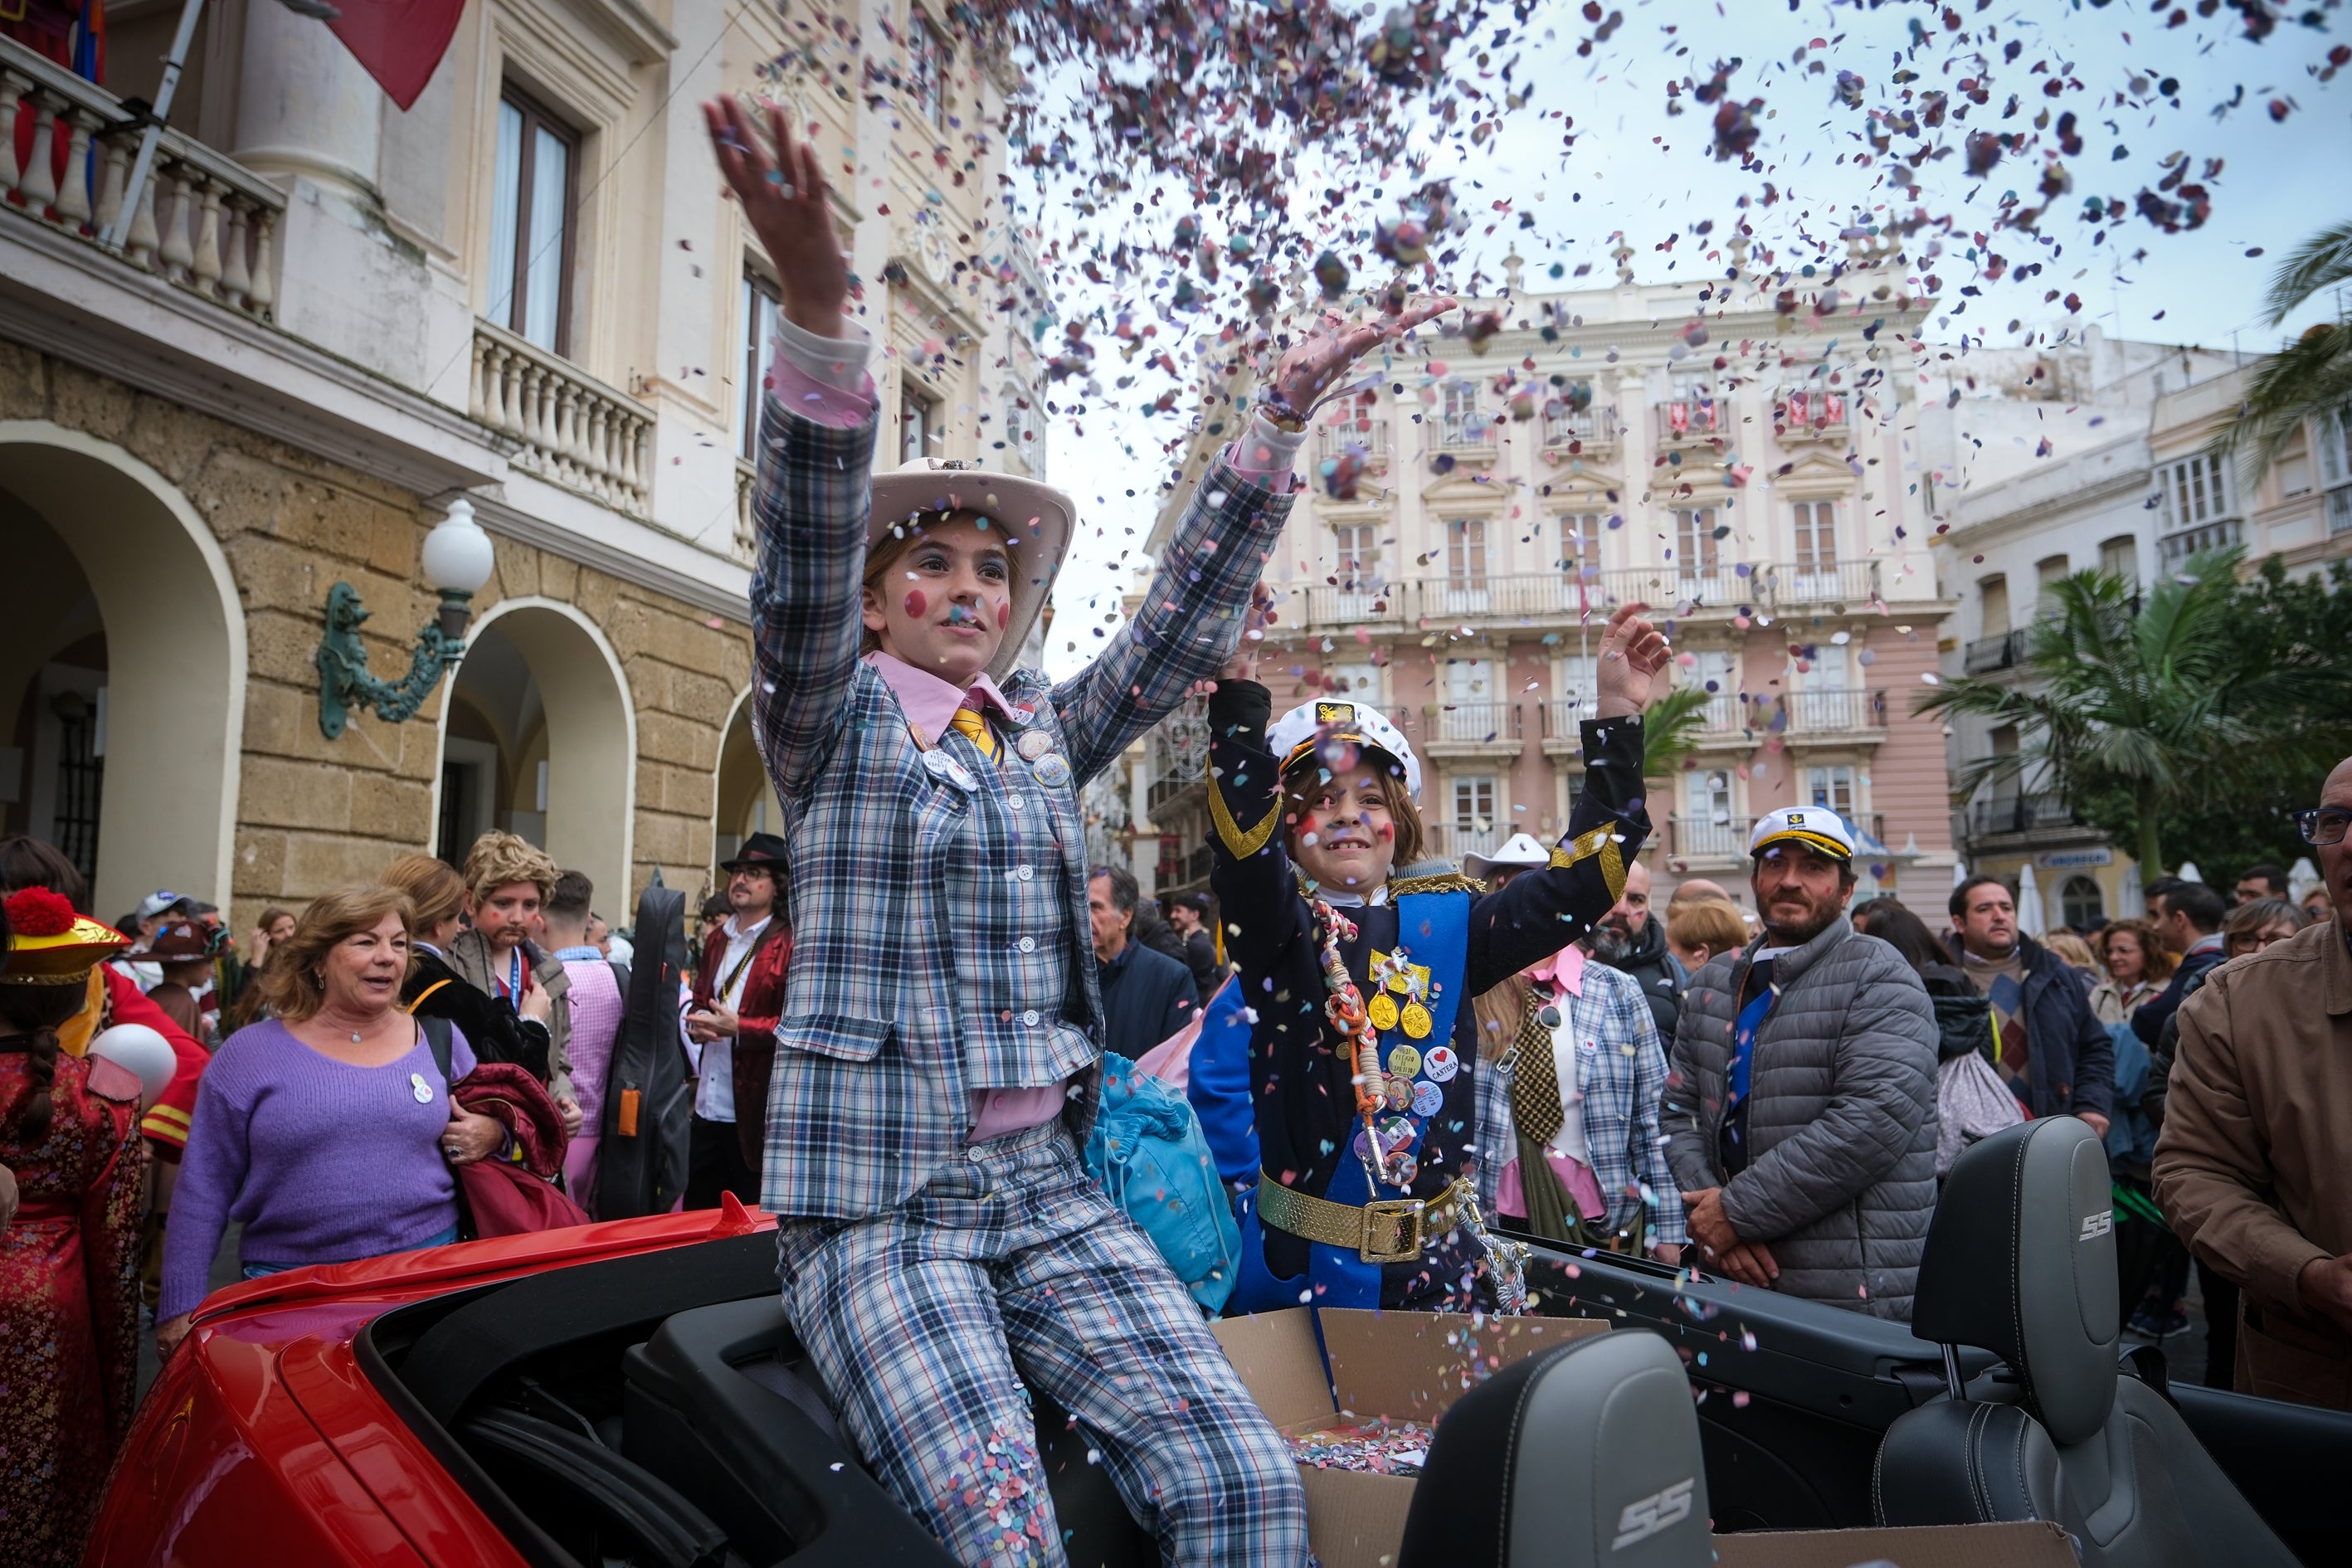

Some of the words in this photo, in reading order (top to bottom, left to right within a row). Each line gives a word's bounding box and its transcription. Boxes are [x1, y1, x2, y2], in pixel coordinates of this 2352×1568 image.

[1427, 1057, 1437, 1069] I
[1432, 1061, 1458, 1080] CANTERA
[2079, 1210, 2112, 1242] SS
[1611, 1478, 1694, 1551] SS
